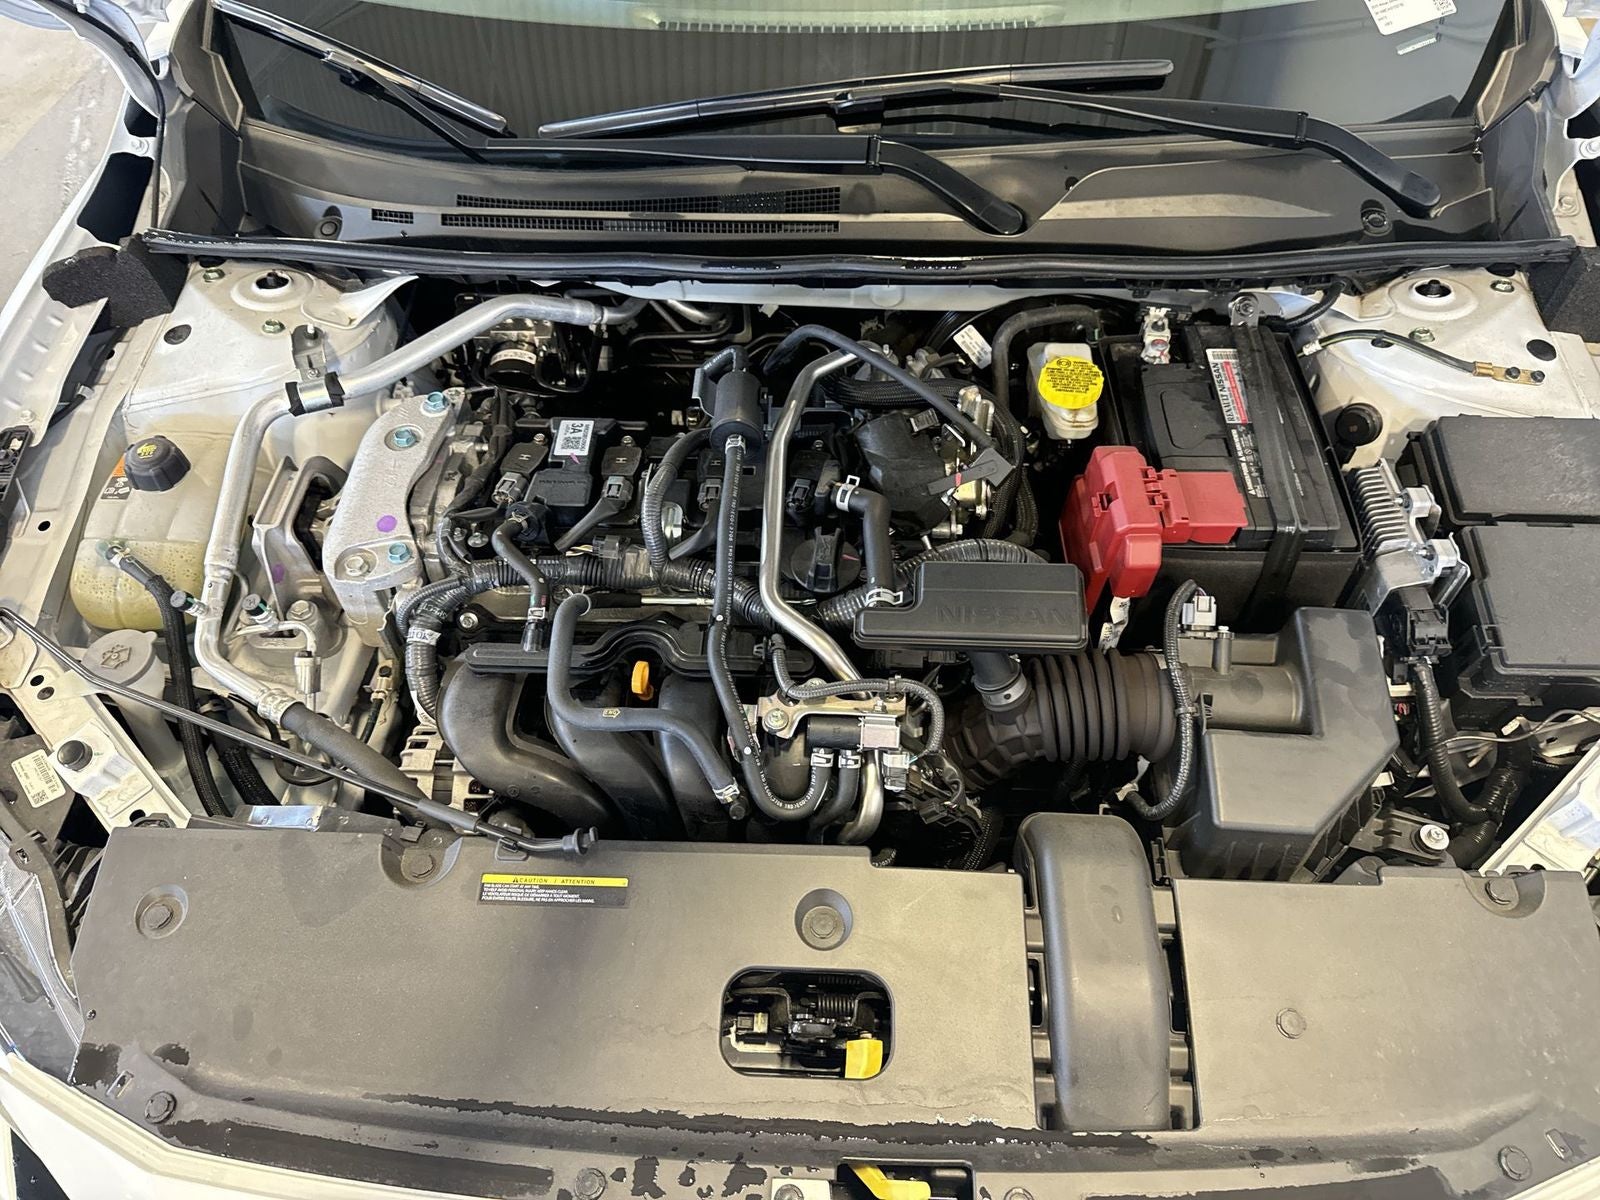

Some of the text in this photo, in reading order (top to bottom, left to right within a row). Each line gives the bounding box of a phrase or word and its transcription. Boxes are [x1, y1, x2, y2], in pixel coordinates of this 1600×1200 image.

[1212, 362, 1226, 392] NISSAN
[570, 423, 583, 434] 3A
[935, 605, 1075, 625] NISSAN
